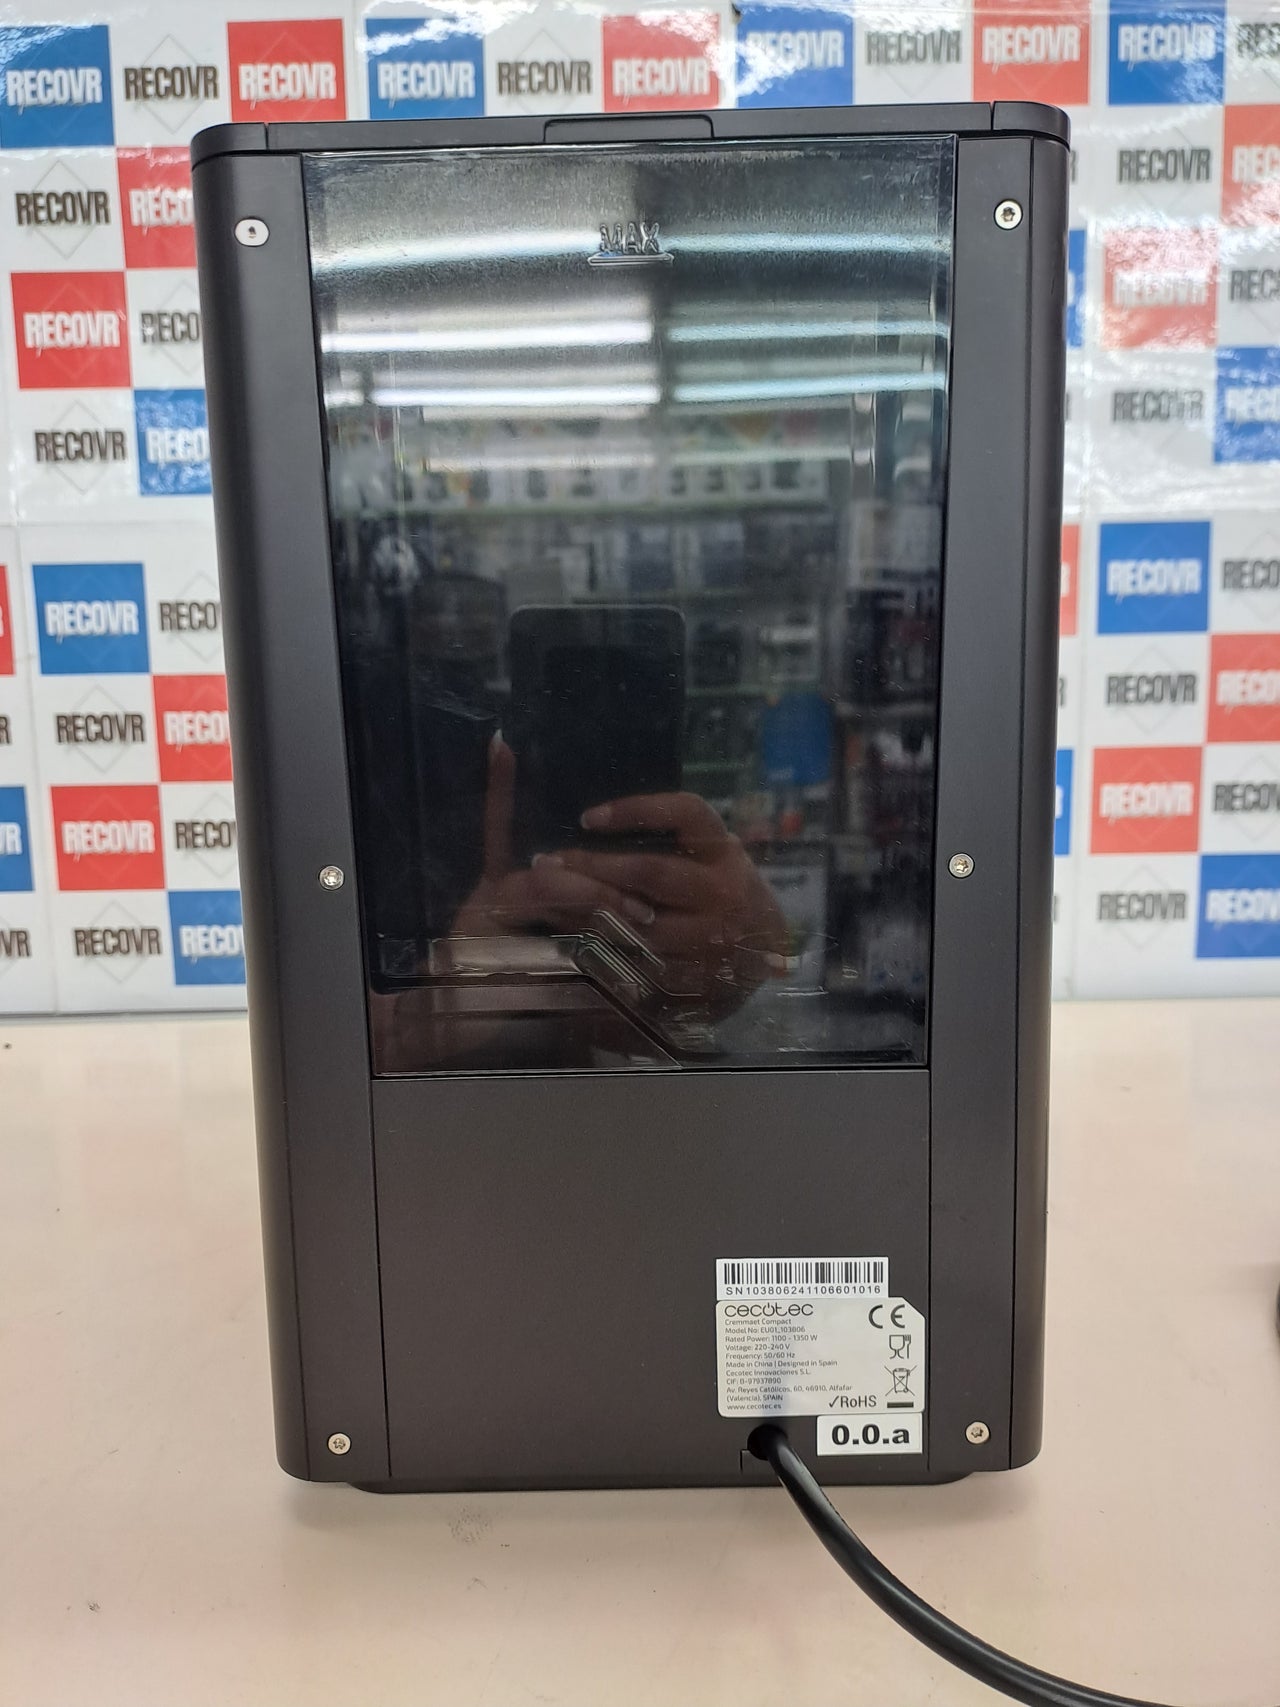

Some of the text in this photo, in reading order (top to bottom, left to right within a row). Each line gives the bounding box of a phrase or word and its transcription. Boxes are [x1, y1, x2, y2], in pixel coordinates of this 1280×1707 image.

[746, 31, 844, 68] RECOVR
[866, 31, 961, 65] RECOVR
[982, 25, 1080, 61] RECOVR
[1119, 24, 1215, 60] RECOVR
[6, 67, 102, 106] RECOVR
[124, 66, 219, 100] RECOVR
[239, 62, 336, 100] RECOVR
[378, 61, 475, 99] RECOVR
[498, 61, 591, 94] RECOVR
[613, 58, 709, 95] RECOVR
[1119, 149, 1211, 183] RECOVR
[16, 191, 110, 225] RECOVR
[599, 222, 660, 255] MAX
[23, 311, 120, 349] RECOVR
[1112, 389, 1204, 422] RECOVR
[34, 430, 126, 462] RECOVR
[1106, 558, 1202, 596] RECOVR
[45, 600, 139, 636] RECOVR
[158, 601, 221, 632] RECO
[1107, 673, 1198, 705] RECOVR
[56, 713, 145, 744] RECOVR
[164, 711, 230, 745] RECO
[1100, 781, 1194, 818] RECOVR
[61, 820, 155, 855] RECOVR
[175, 820, 237, 849] RECO
[1097, 892, 1188, 921] RECOVR
[74, 928, 162, 957] RECOVR
[180, 925, 244, 958] RECO
[725, 1285, 881, 1296] SN103806241106601016
[724, 1301, 814, 1317] cecotec
[762, 1318, 792, 1326] Compact
[777, 1360, 810, 1368] Designed
[737, 1386, 758, 1394] Reyes
[841, 1396, 877, 1408] RoHS
[831, 1424, 910, 1445] 0.0.a
